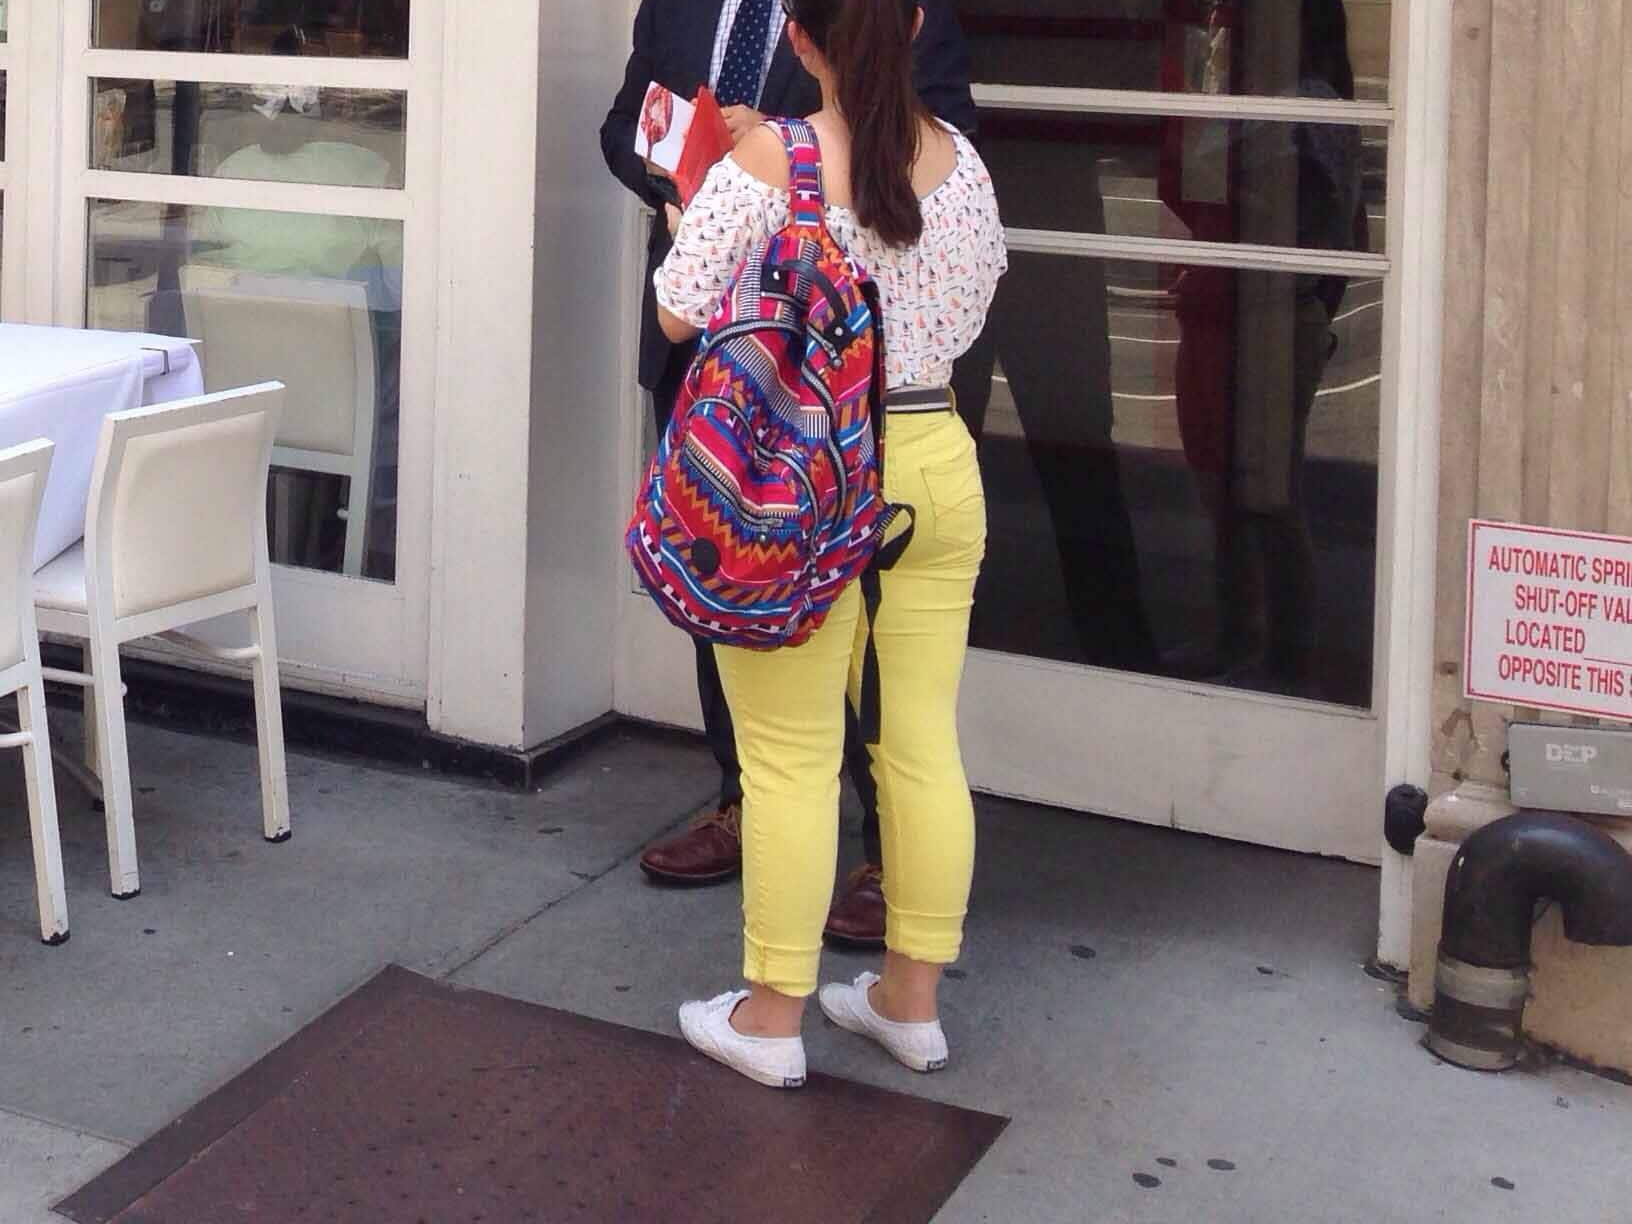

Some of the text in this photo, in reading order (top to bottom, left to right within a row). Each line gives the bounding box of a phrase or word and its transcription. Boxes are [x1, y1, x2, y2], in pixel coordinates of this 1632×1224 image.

[1488, 545, 1632, 588] AUTOMATIC SPRI
[1514, 584, 1598, 620] SHUT-OFF
[1505, 619, 1586, 654] LOCATED
[1498, 654, 1582, 691] OPPOSITE
[1587, 666, 1624, 697] THIS
